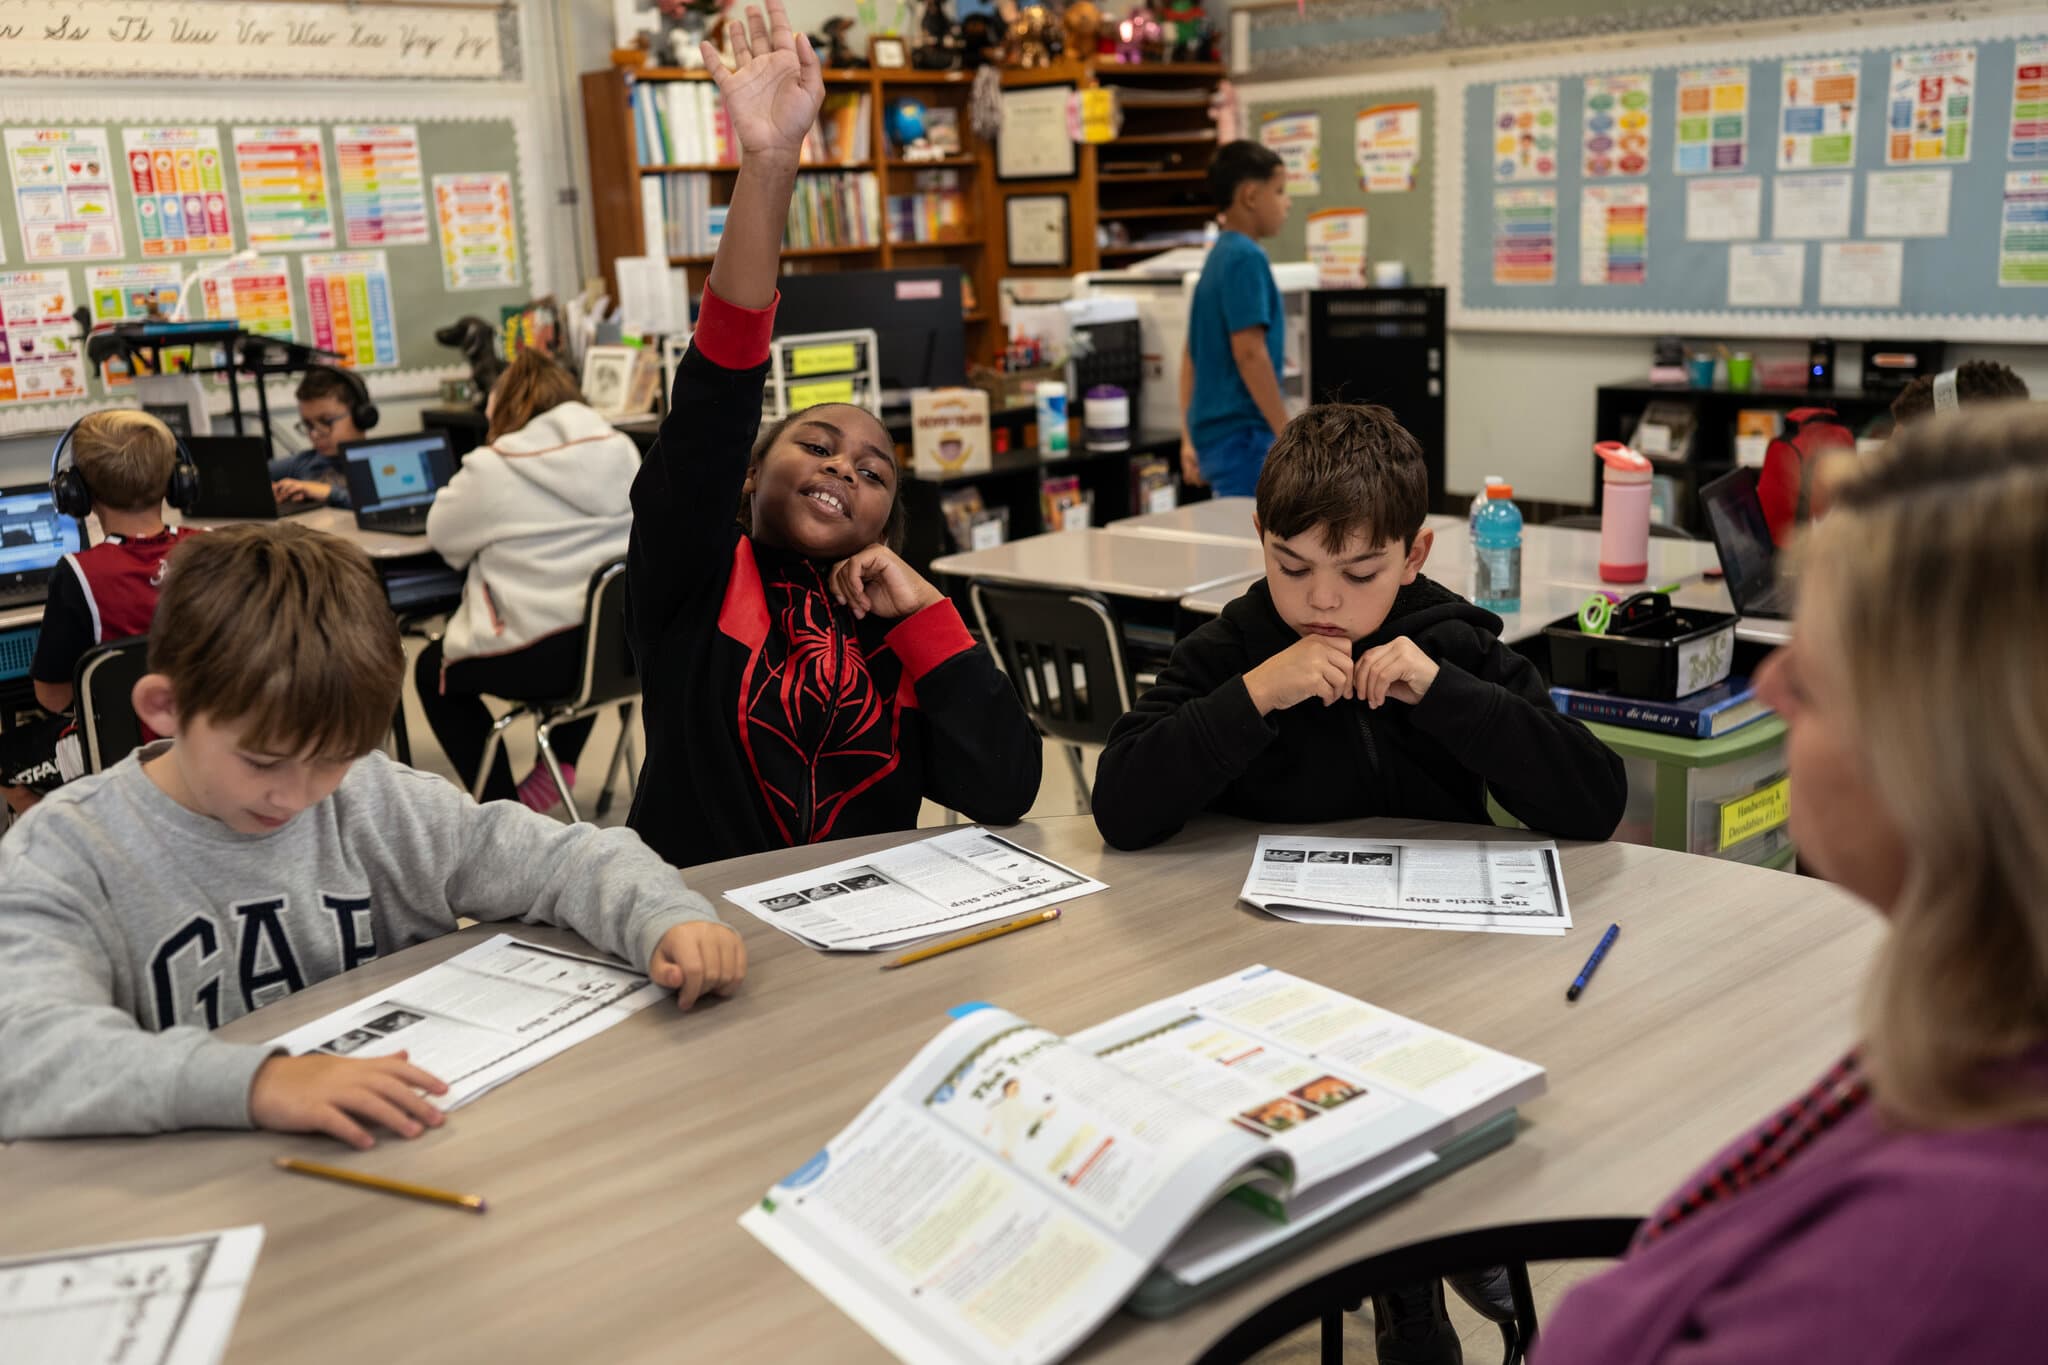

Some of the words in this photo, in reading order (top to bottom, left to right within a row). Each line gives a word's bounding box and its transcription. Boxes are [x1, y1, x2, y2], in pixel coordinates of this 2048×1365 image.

[44, 15, 90, 41] Ss
[1404, 896, 1440, 904] Ship
[1445, 898, 1496, 906] Turtle
